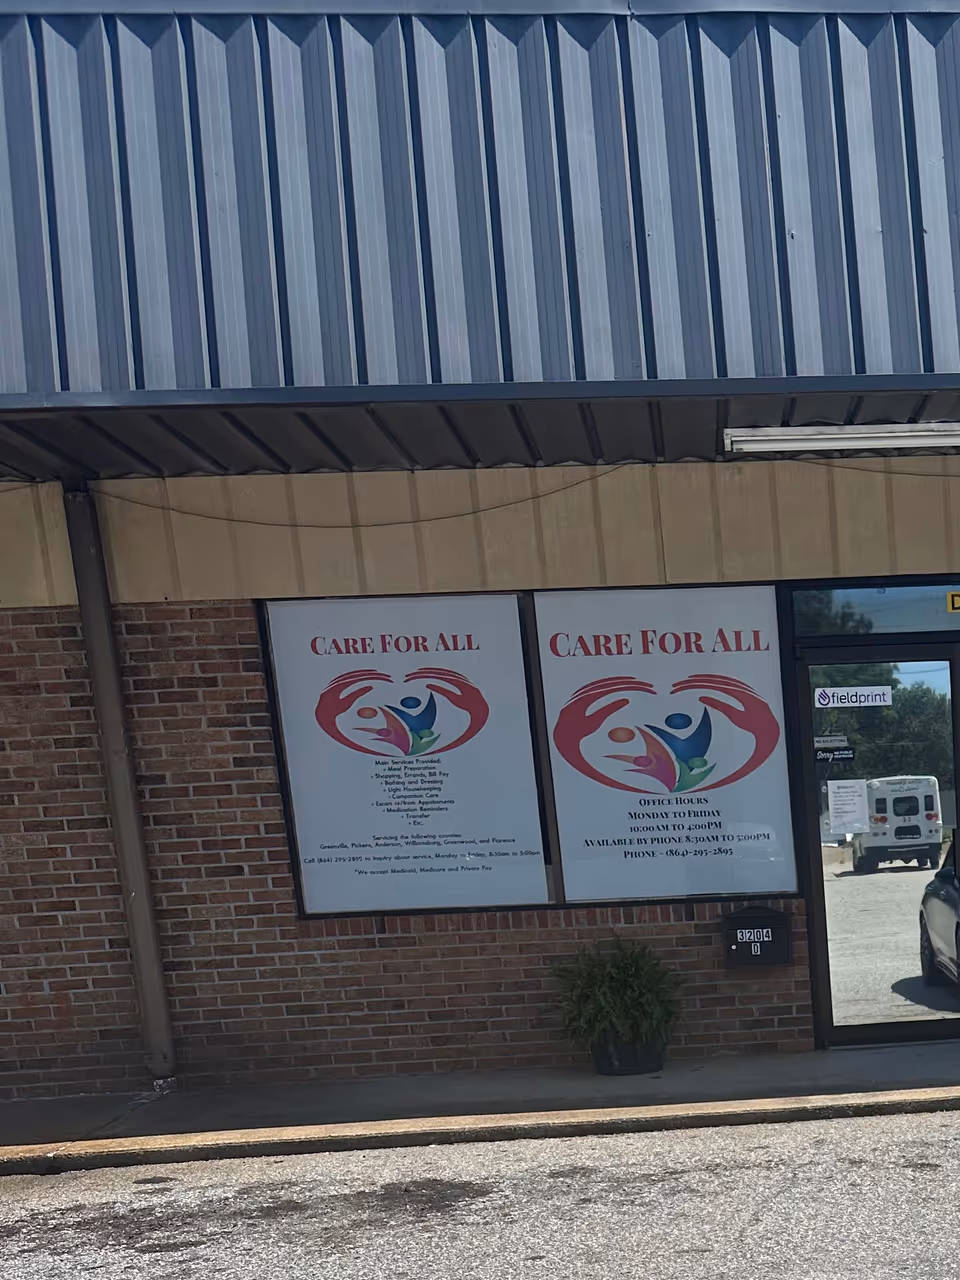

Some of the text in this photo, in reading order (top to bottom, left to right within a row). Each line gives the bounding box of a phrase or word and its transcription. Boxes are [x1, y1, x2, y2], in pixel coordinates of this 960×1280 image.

[309, 630, 480, 655] CARE FOR ALL
[547, 625, 770, 658] CARE FOR ALL
[832, 692, 887, 704] fieldprint
[638, 796, 708, 806] OFFICE HOURS
[627, 810, 669, 819] MONDAY
[687, 808, 721, 817] FRIDAY
[636, 836, 649, 845] BY
[650, 835, 683, 844] PHONE
[685, 834, 719, 844] 8:30AM
[623, 849, 657, 858] PHONE
[738, 929, 772, 941] 3204
